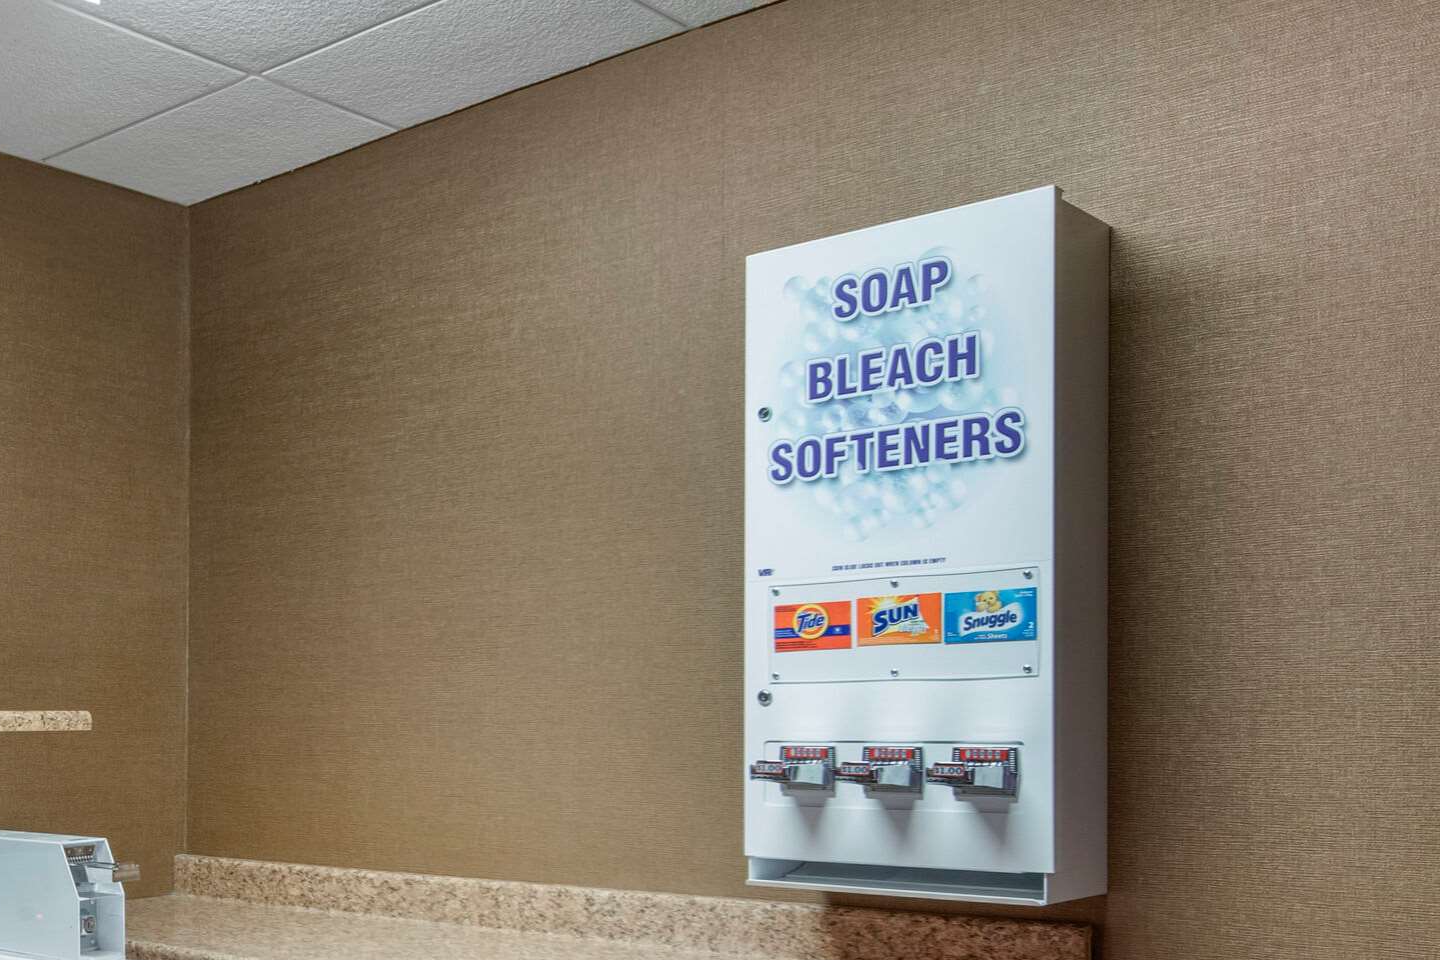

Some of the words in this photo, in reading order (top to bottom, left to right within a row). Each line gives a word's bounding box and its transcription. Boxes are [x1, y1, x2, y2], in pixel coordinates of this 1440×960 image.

[832, 257, 950, 320] SOAP
[807, 333, 978, 402] BLEACH
[769, 410, 1024, 483] SOFTENERS
[796, 612, 825, 632] Tide
[873, 603, 919, 634] SUN
[963, 610, 1017, 631] Snuggle
